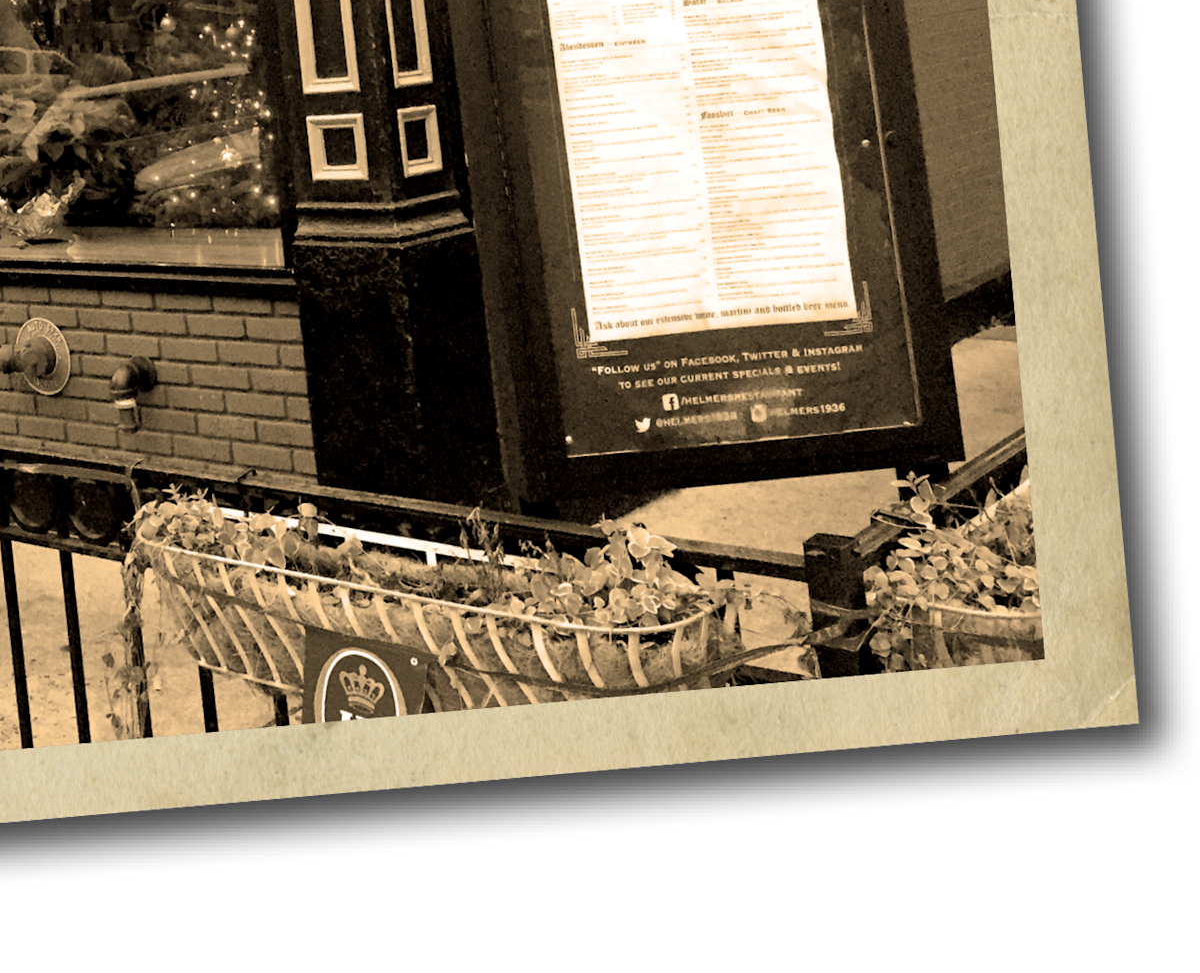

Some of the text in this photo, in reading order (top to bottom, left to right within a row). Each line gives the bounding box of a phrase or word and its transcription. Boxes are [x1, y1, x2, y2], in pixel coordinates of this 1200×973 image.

[664, 359, 677, 369] ON
[742, 349, 788, 362] TWITTER
[803, 344, 863, 357] INSTAGRAM
[618, 381, 632, 389] TO
[634, 379, 655, 389] SEE
[657, 376, 677, 386] OUR
[680, 372, 729, 384] CURRENT
[732, 367, 781, 379] SPECIALS
[797, 361, 842, 374] EVENTS!
